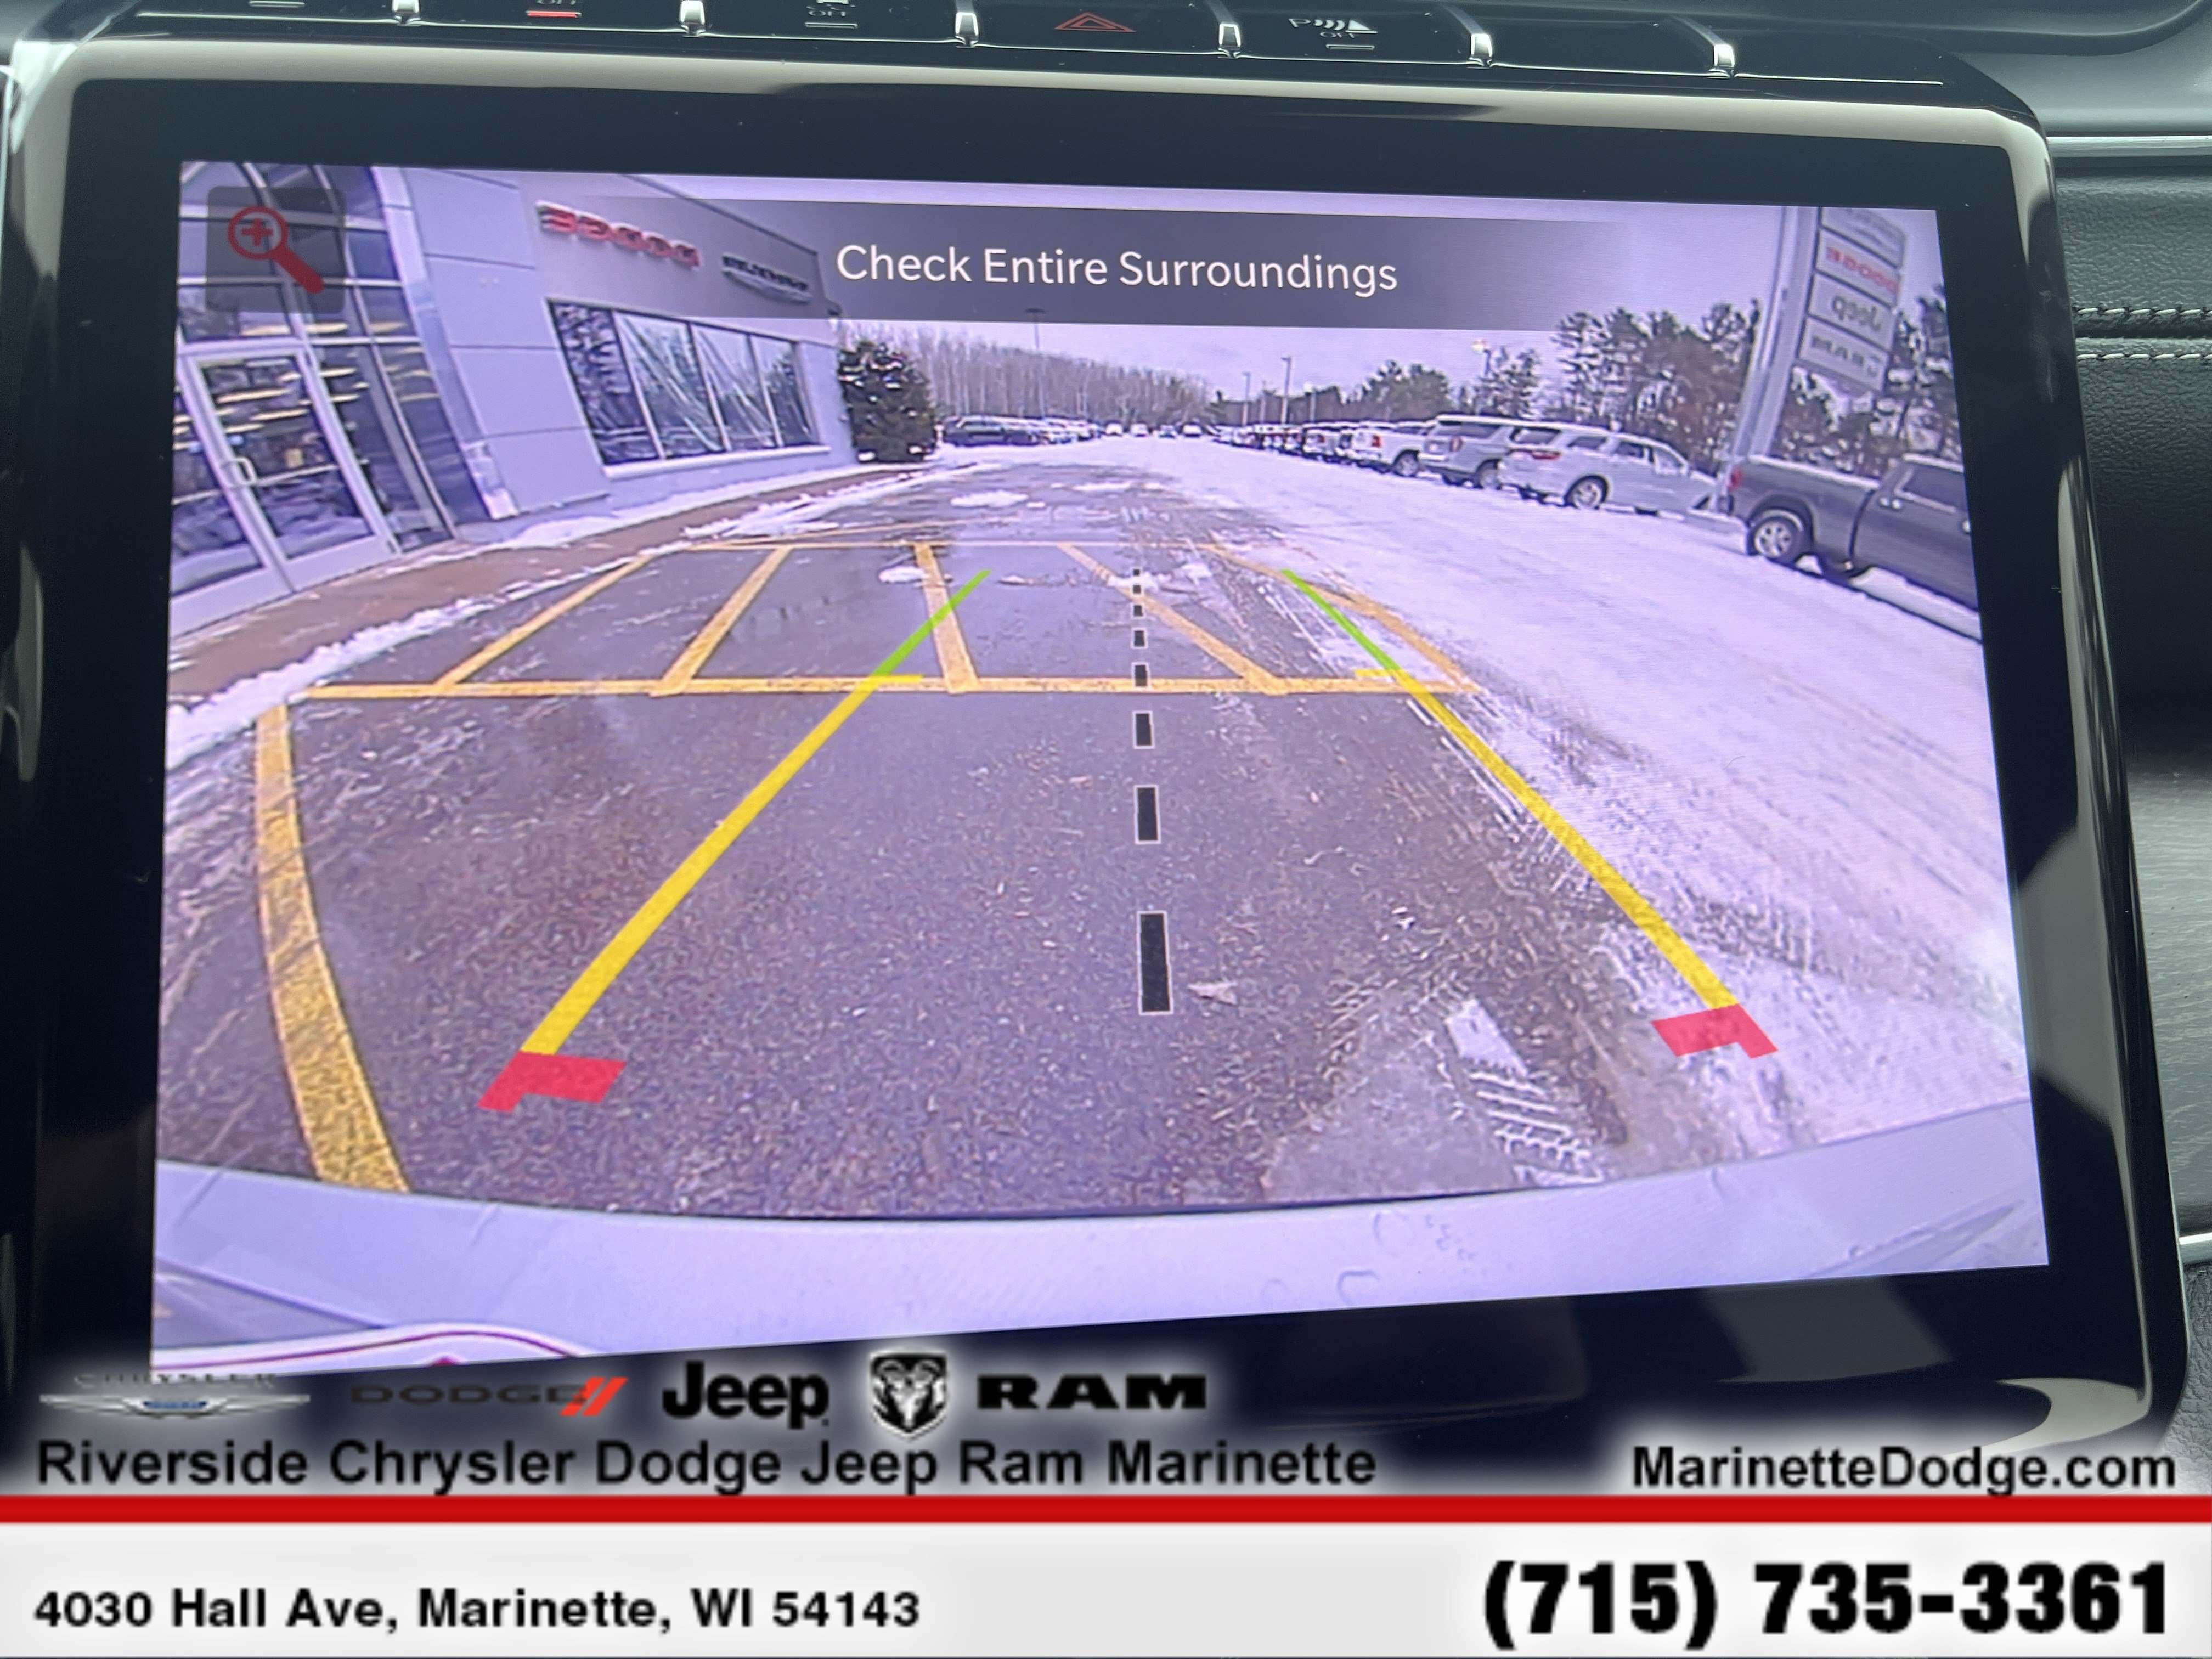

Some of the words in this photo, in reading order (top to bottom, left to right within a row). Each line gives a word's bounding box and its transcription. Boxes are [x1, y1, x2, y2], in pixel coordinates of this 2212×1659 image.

[836, 244, 972, 283] Check
[984, 248, 1108, 285] Entire
[1119, 251, 1398, 298] Surroundings
